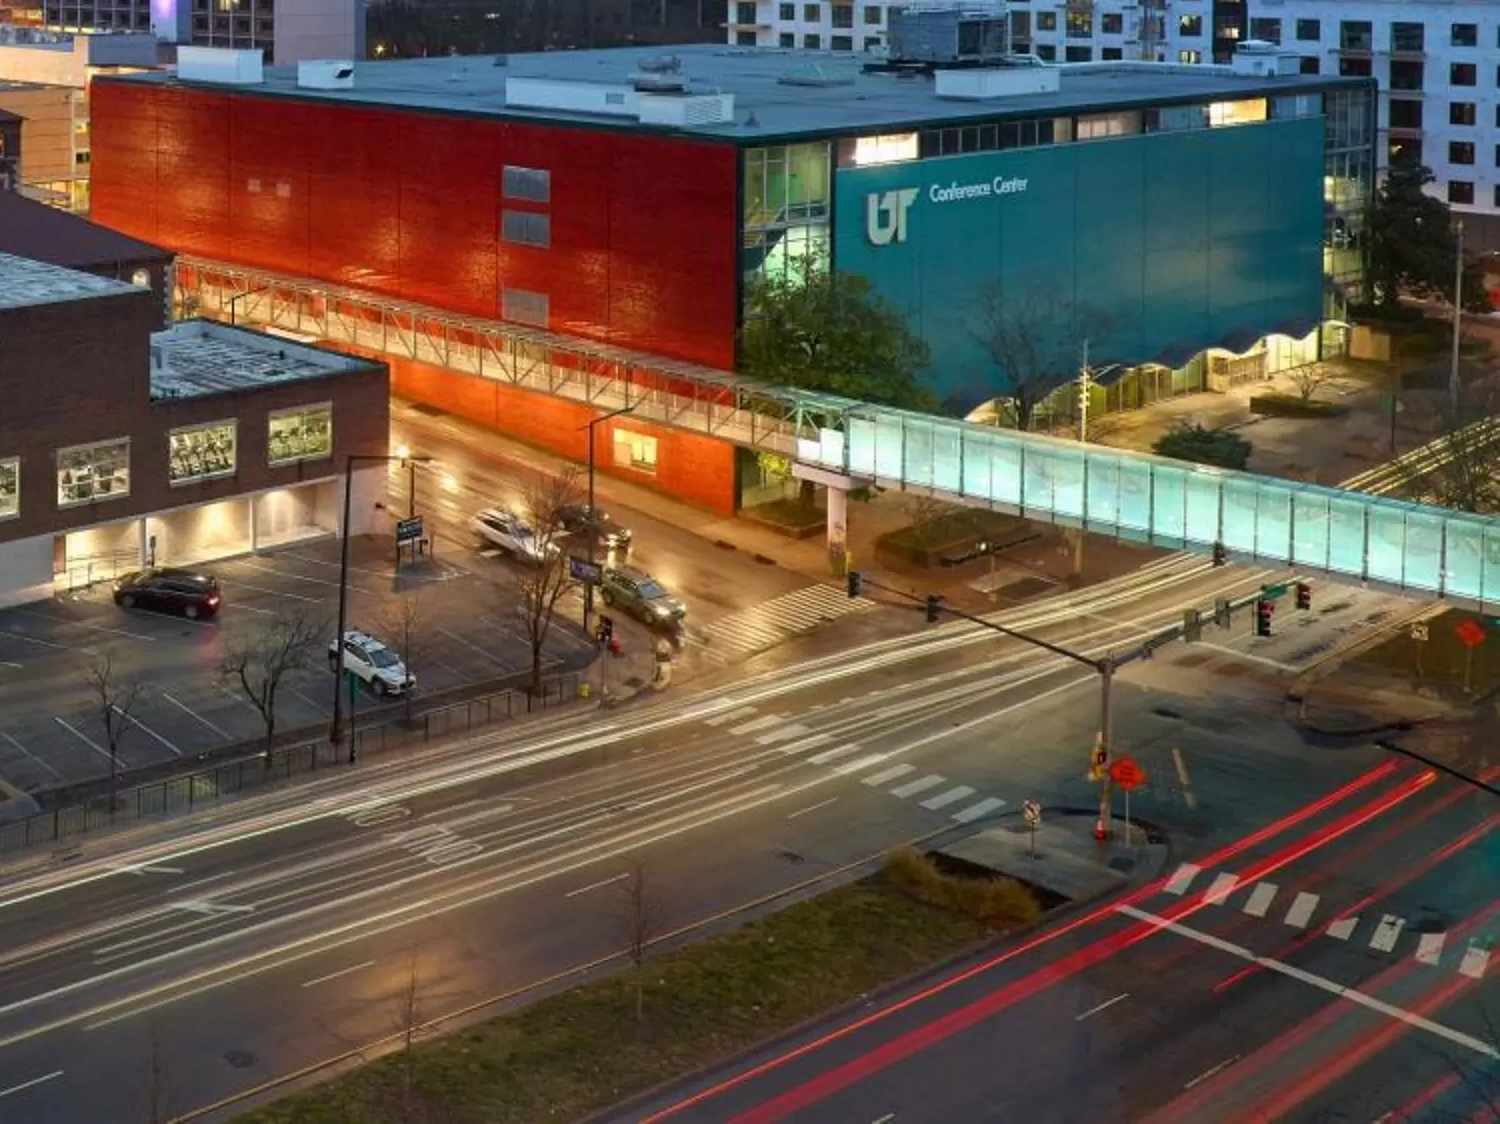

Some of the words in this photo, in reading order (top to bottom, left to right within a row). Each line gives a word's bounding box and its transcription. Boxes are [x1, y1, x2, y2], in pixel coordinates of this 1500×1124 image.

[929, 181, 991, 203] Conference
[993, 176, 1029, 195] Center
[867, 187, 920, 246] UT
[381, 823, 485, 865] ONLY
